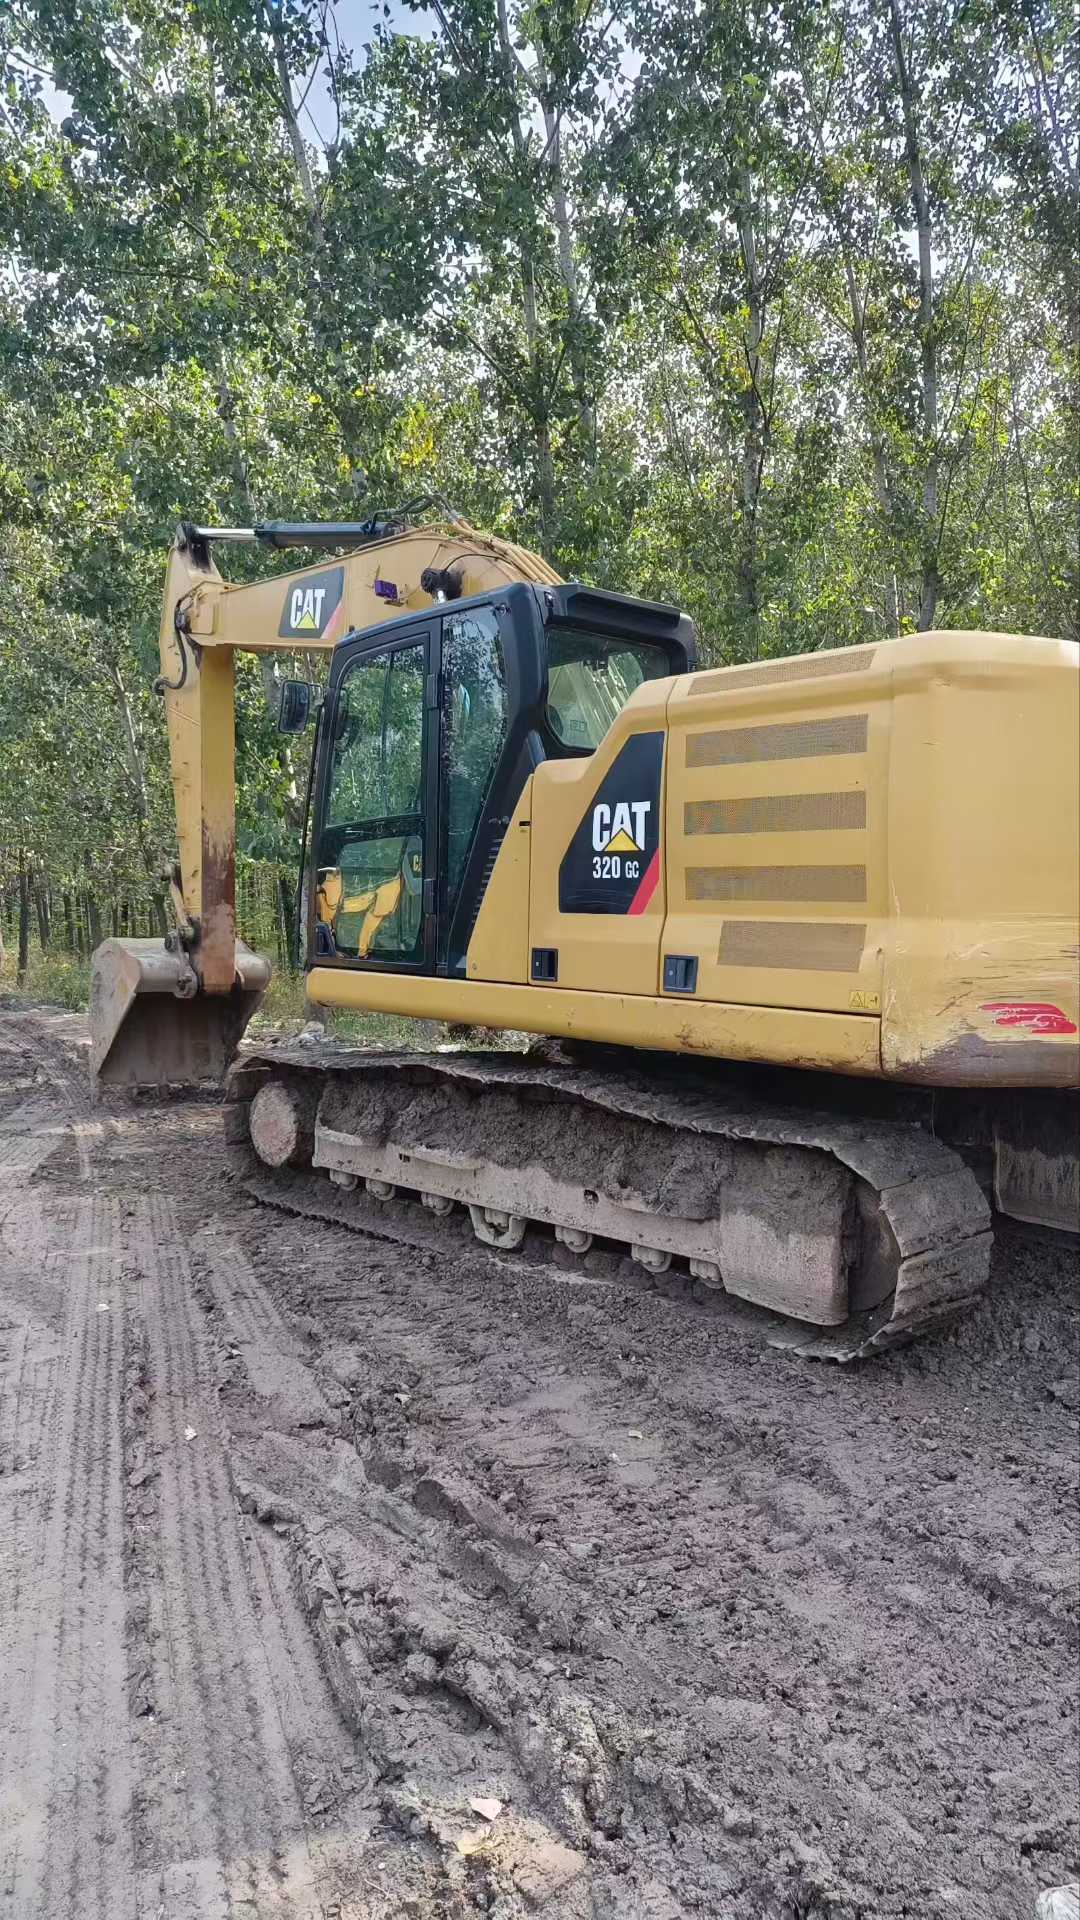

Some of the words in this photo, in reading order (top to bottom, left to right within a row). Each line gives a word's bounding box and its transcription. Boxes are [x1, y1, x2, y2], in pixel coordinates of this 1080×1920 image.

[290, 588, 326, 629] CAT
[592, 801, 651, 851] CAT
[592, 855, 621, 879] 320
[625, 860, 640, 879] GC
